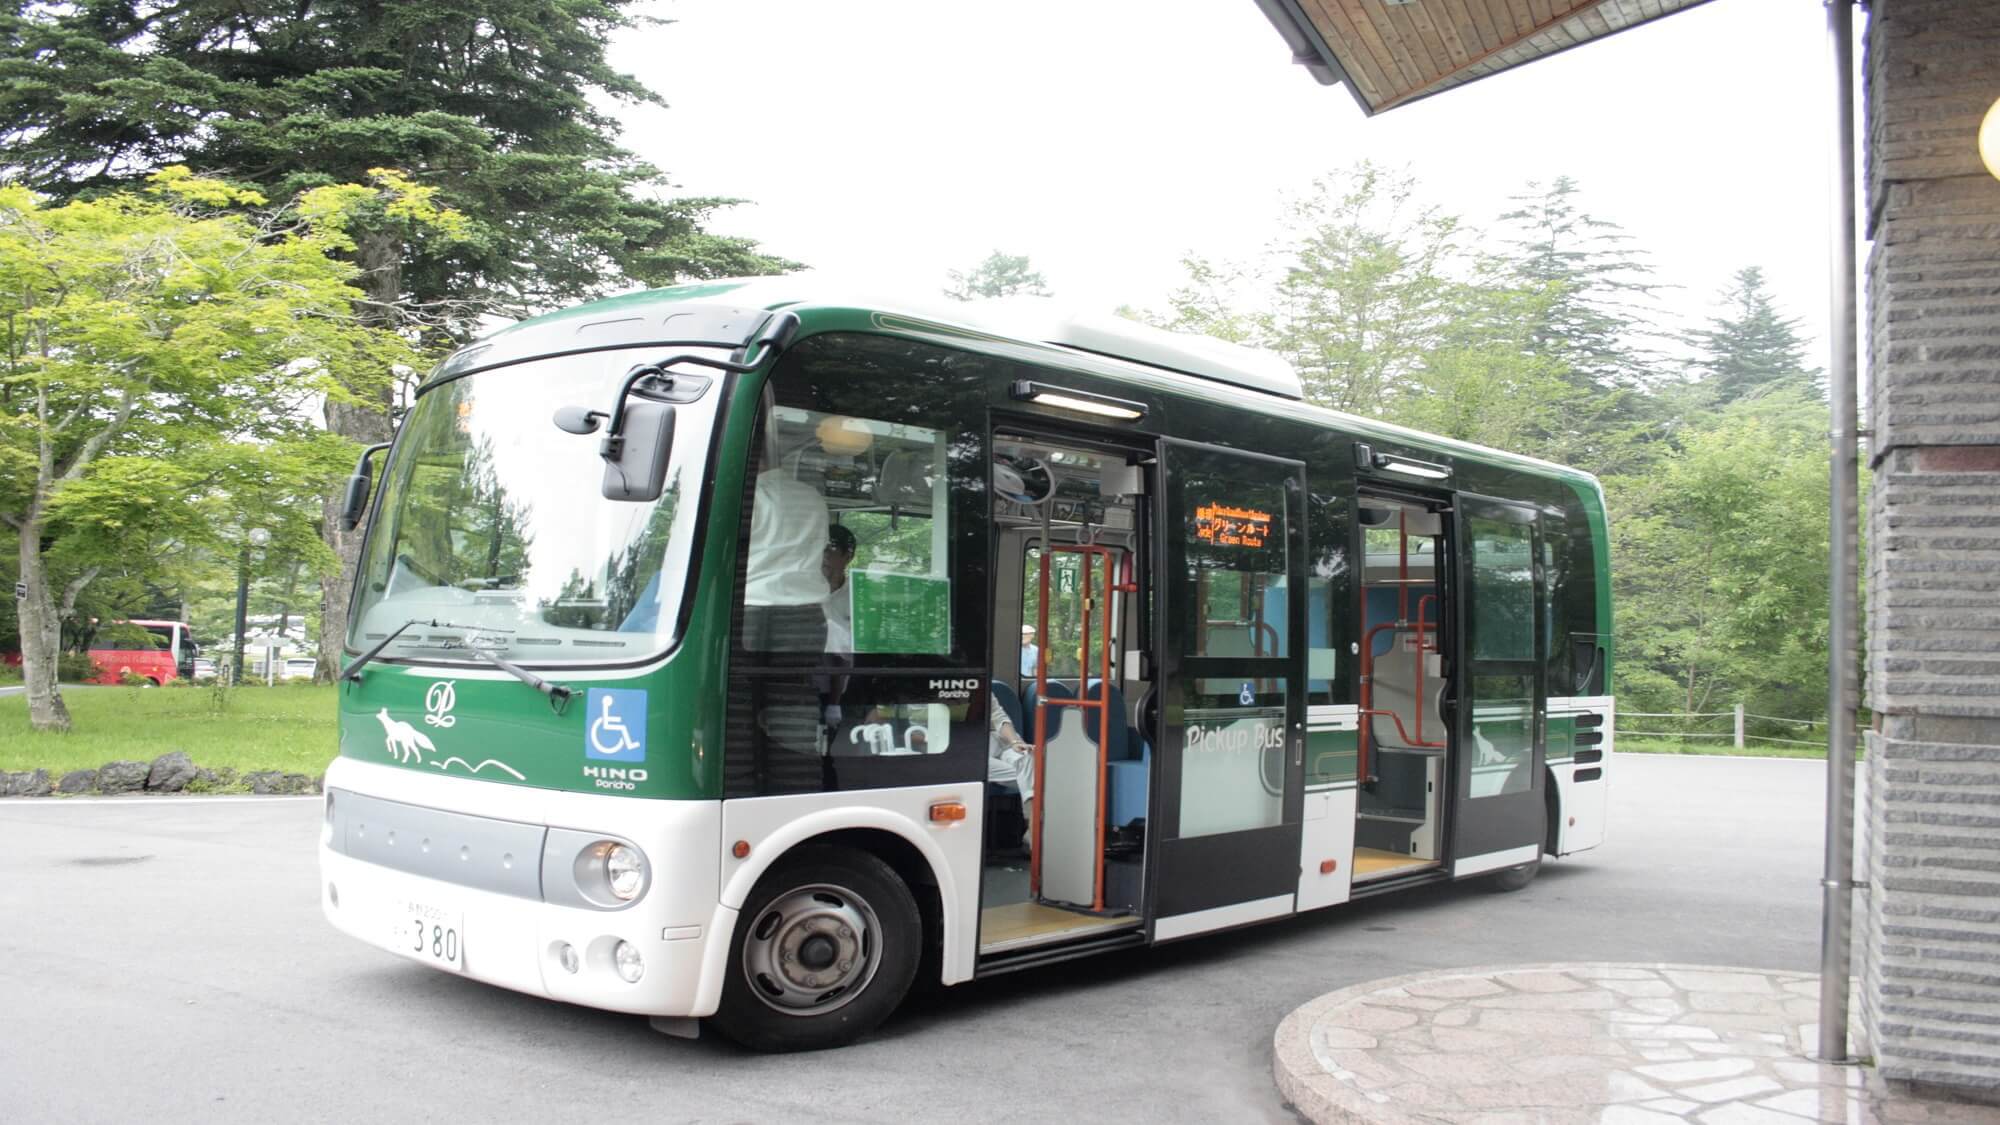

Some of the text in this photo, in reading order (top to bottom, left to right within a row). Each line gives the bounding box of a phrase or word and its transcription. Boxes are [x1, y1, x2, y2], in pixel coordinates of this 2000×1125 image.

[1219, 532, 1240, 545] Green
[928, 679, 979, 689] HINO
[1186, 722, 1284, 754] Pickup Bus
[583, 766, 648, 782] HINO
[595, 778, 635, 790] Poncho
